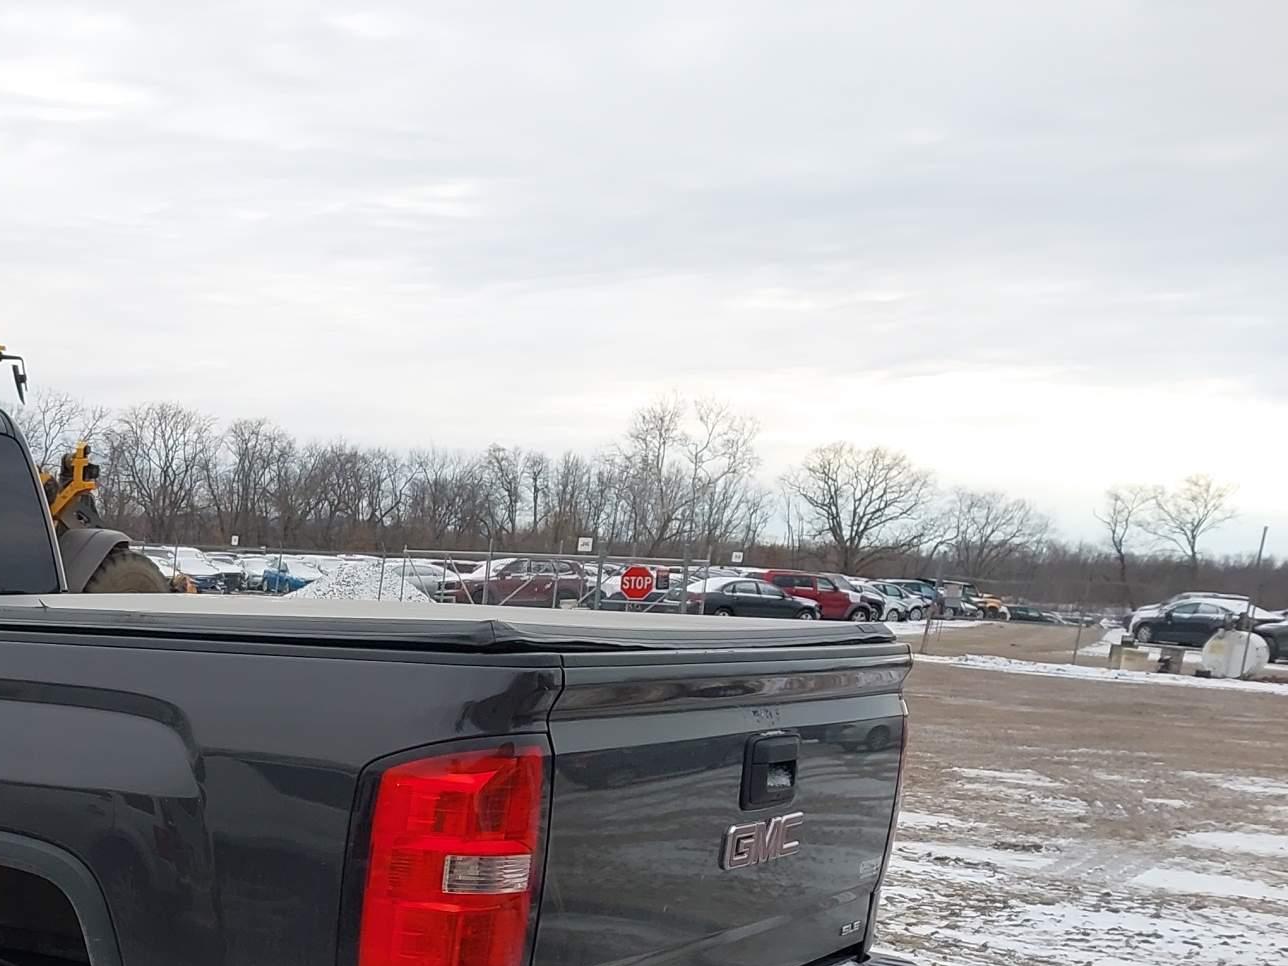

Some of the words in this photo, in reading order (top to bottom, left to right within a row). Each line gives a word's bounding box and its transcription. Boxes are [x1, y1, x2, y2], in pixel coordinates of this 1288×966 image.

[622, 576, 653, 590] STOP
[722, 811, 805, 870] GMC
[841, 920, 861, 936] SLE
